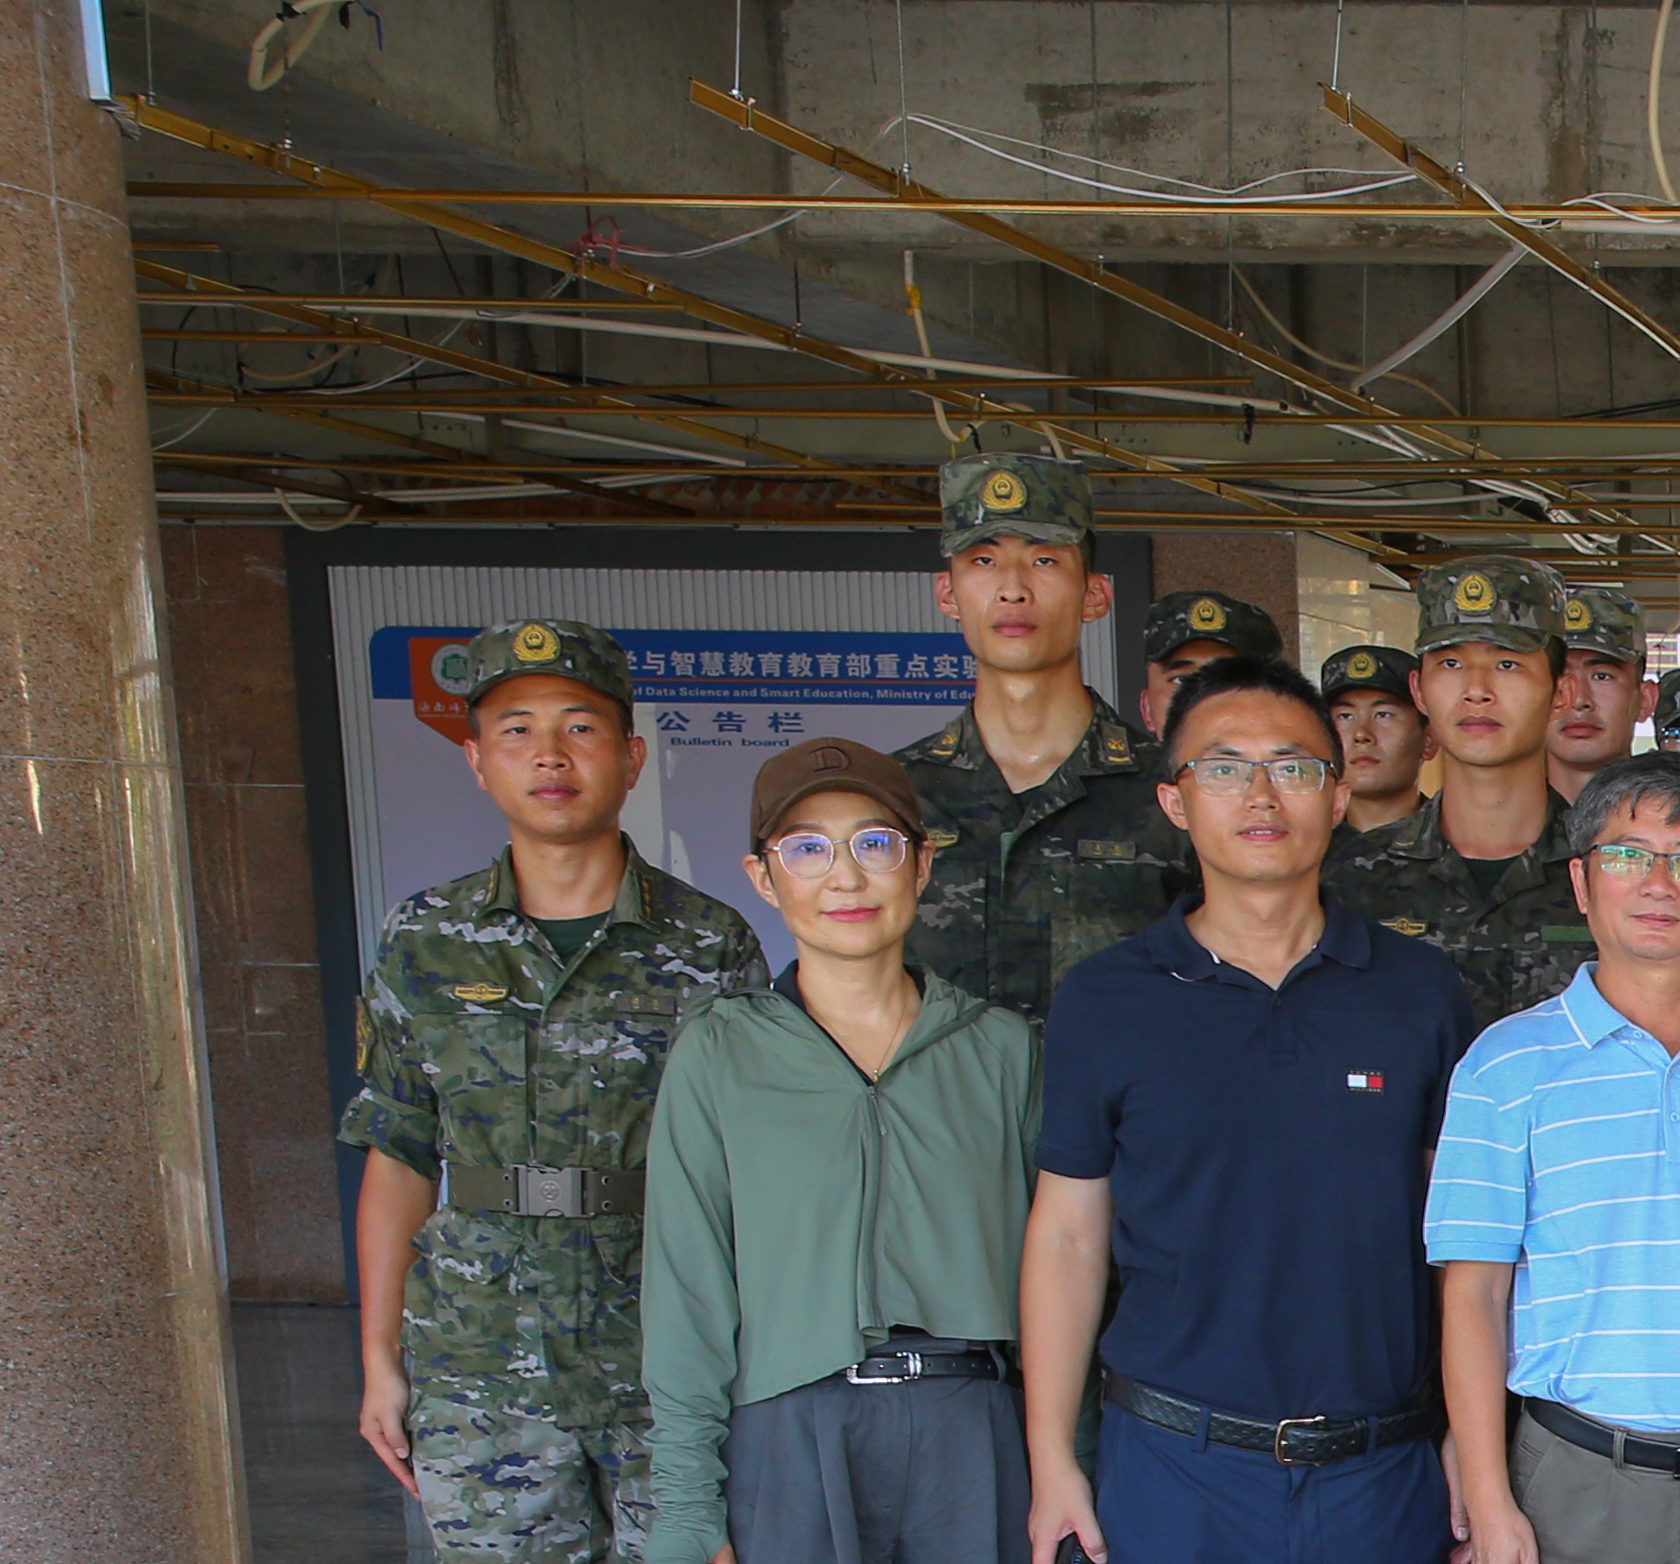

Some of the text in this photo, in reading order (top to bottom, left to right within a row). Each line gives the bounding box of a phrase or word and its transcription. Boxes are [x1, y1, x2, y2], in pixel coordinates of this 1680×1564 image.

[646, 688, 676, 697] Data
[679, 688, 729, 697] Science
[733, 688, 754, 697] and
[760, 688, 800, 698] Smart
[803, 689, 873, 699] Education,
[877, 689, 931, 701] Ministry
[935, 689, 947, 700] of
[670, 737, 790, 747] Bulletin board
[809, 746, 850, 773] D
